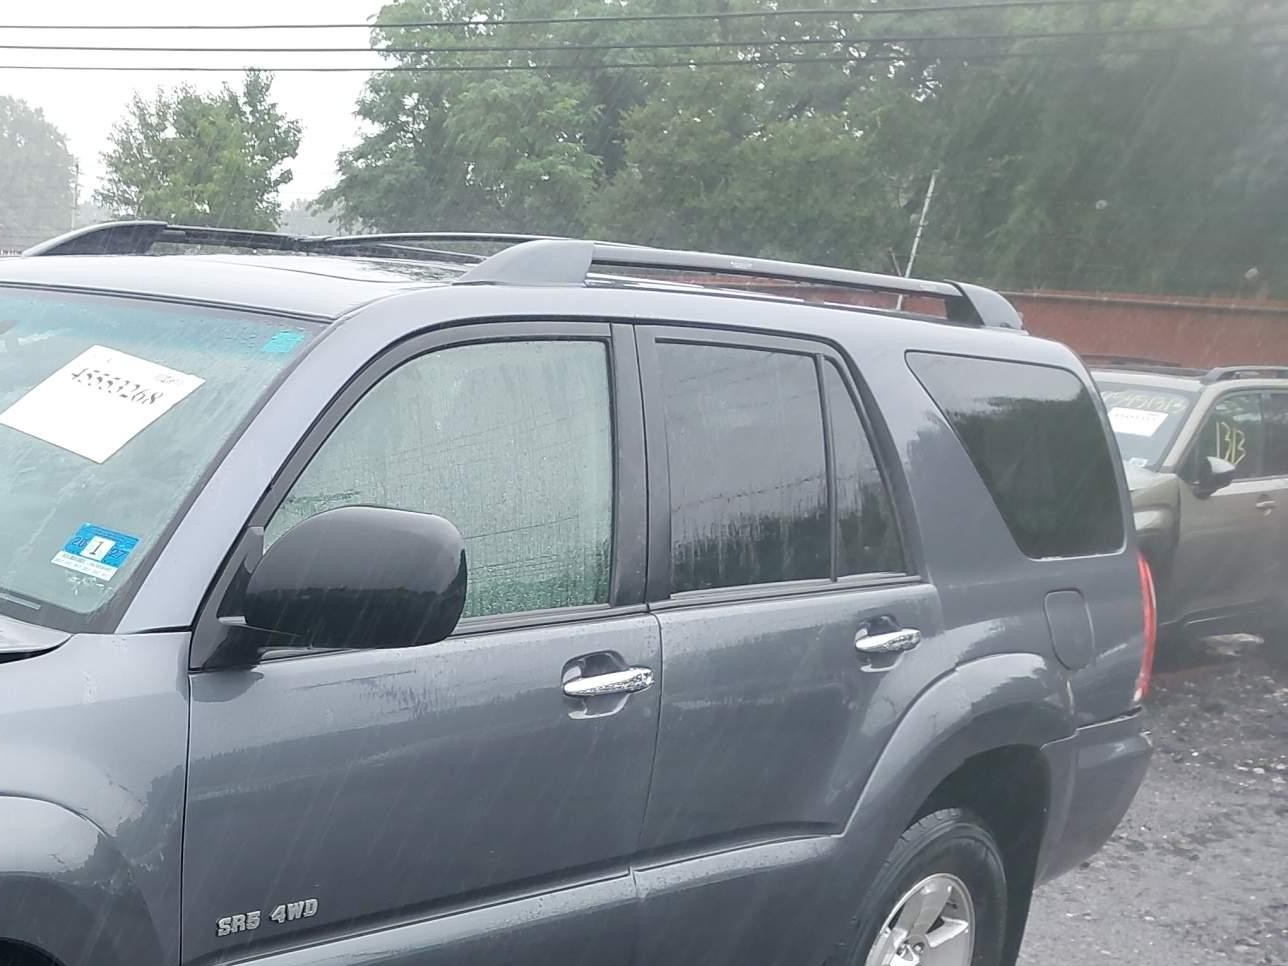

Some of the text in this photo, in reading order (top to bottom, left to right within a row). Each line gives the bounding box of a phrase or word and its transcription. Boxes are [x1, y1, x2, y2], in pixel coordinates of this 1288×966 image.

[72, 368, 164, 405] 45553268
[217, 898, 319, 936] SR5 4WD
